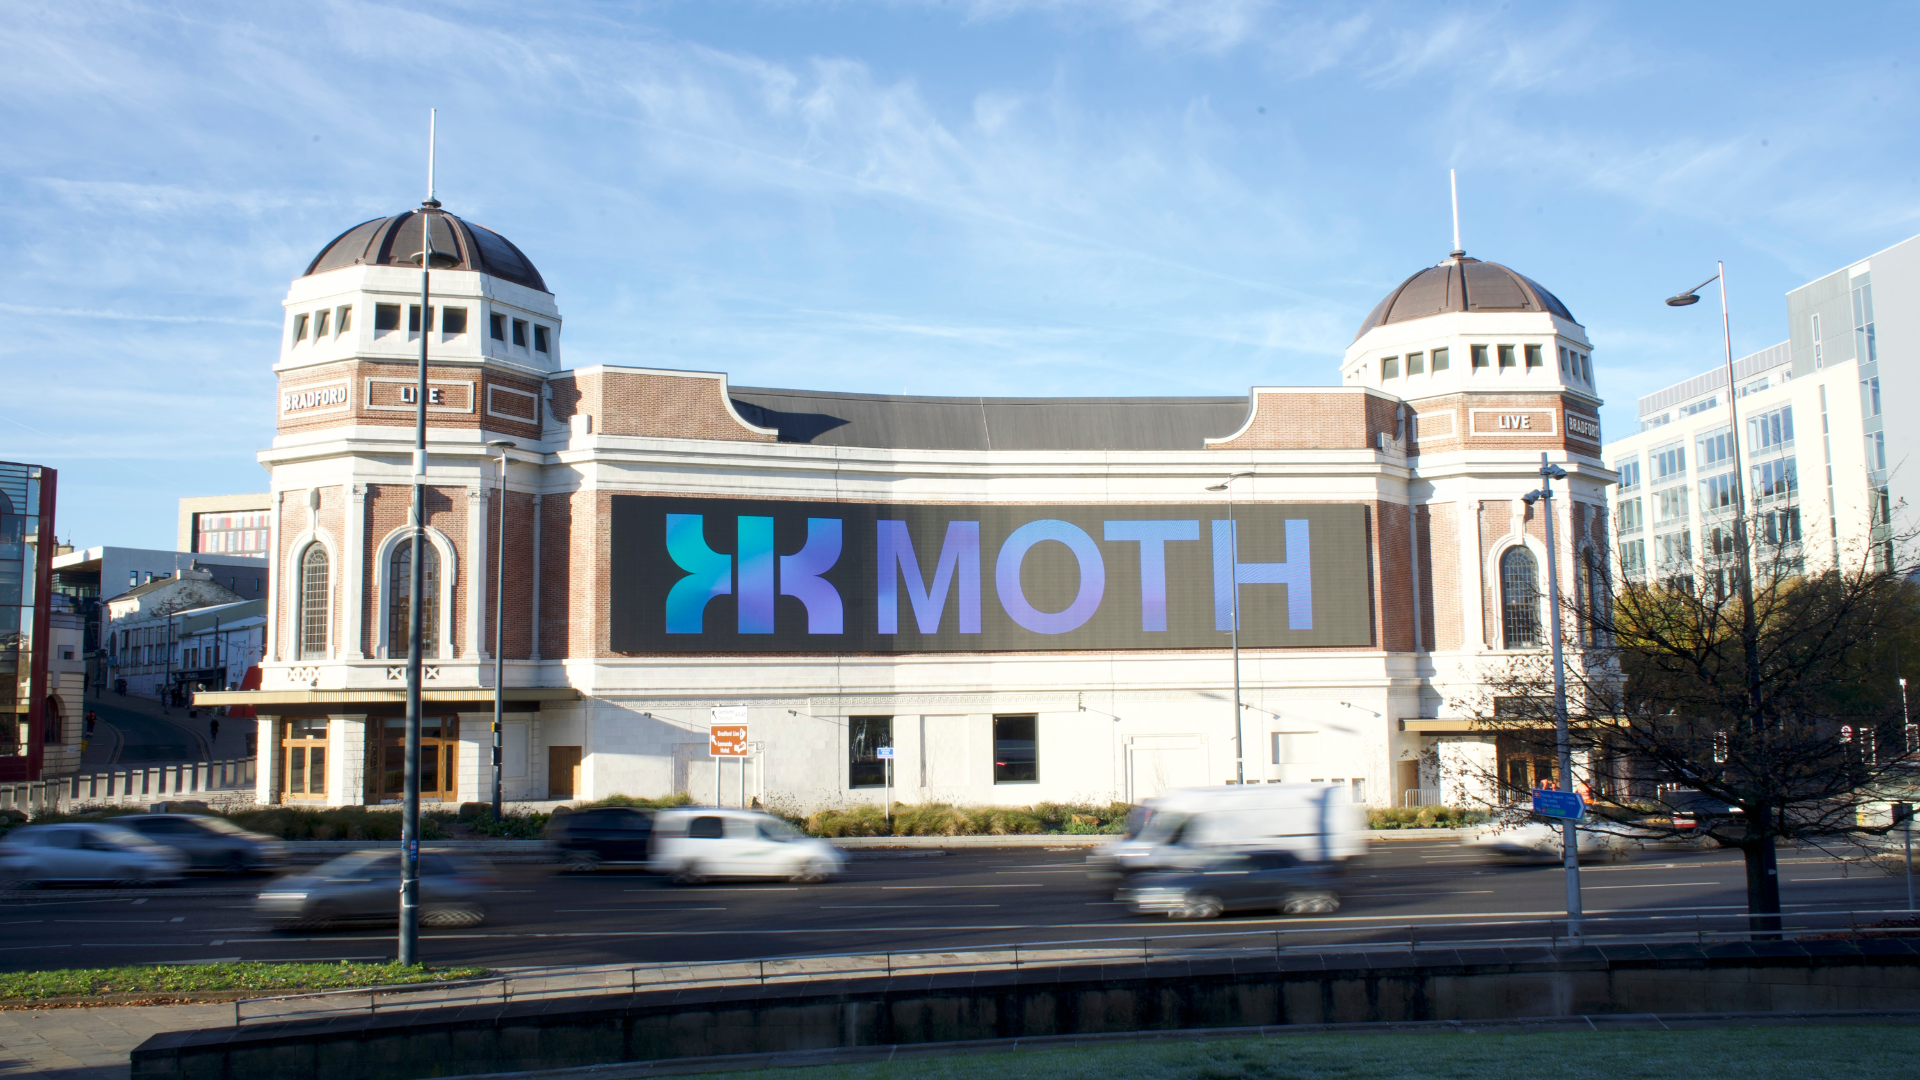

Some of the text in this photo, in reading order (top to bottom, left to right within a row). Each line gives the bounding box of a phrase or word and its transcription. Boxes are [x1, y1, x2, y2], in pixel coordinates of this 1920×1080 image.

[284, 387, 346, 410] BRADFORD
[400, 387, 439, 403] LIE
[1498, 415, 1530, 429] LIVE
[1568, 416, 1599, 438] BRADFORD
[876, 519, 1313, 635] MOTH
